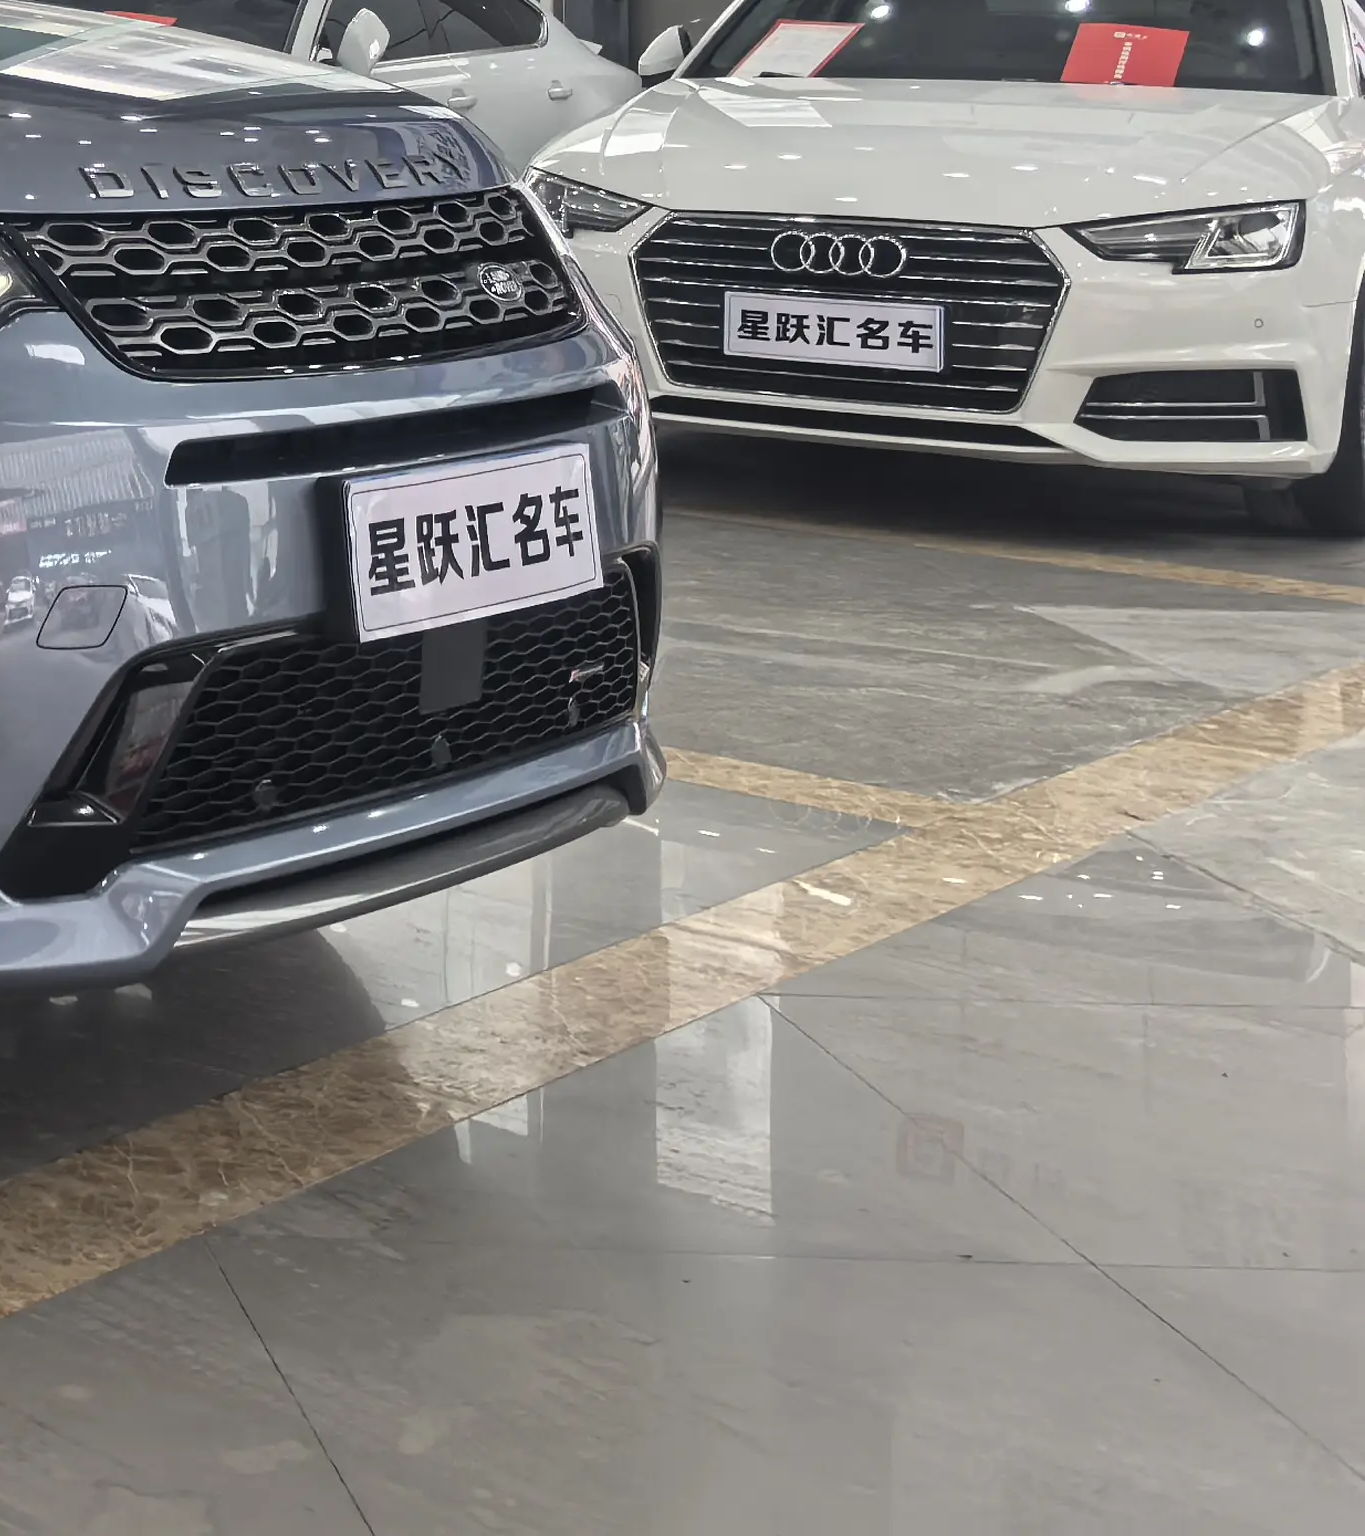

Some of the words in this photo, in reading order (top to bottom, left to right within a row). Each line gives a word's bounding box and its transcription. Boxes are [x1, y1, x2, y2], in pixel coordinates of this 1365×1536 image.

[80, 151, 471, 199] DISCOVERY
[737, 309, 935, 354] 星跃汇名车
[368, 485, 584, 597] 星跃汇名车
